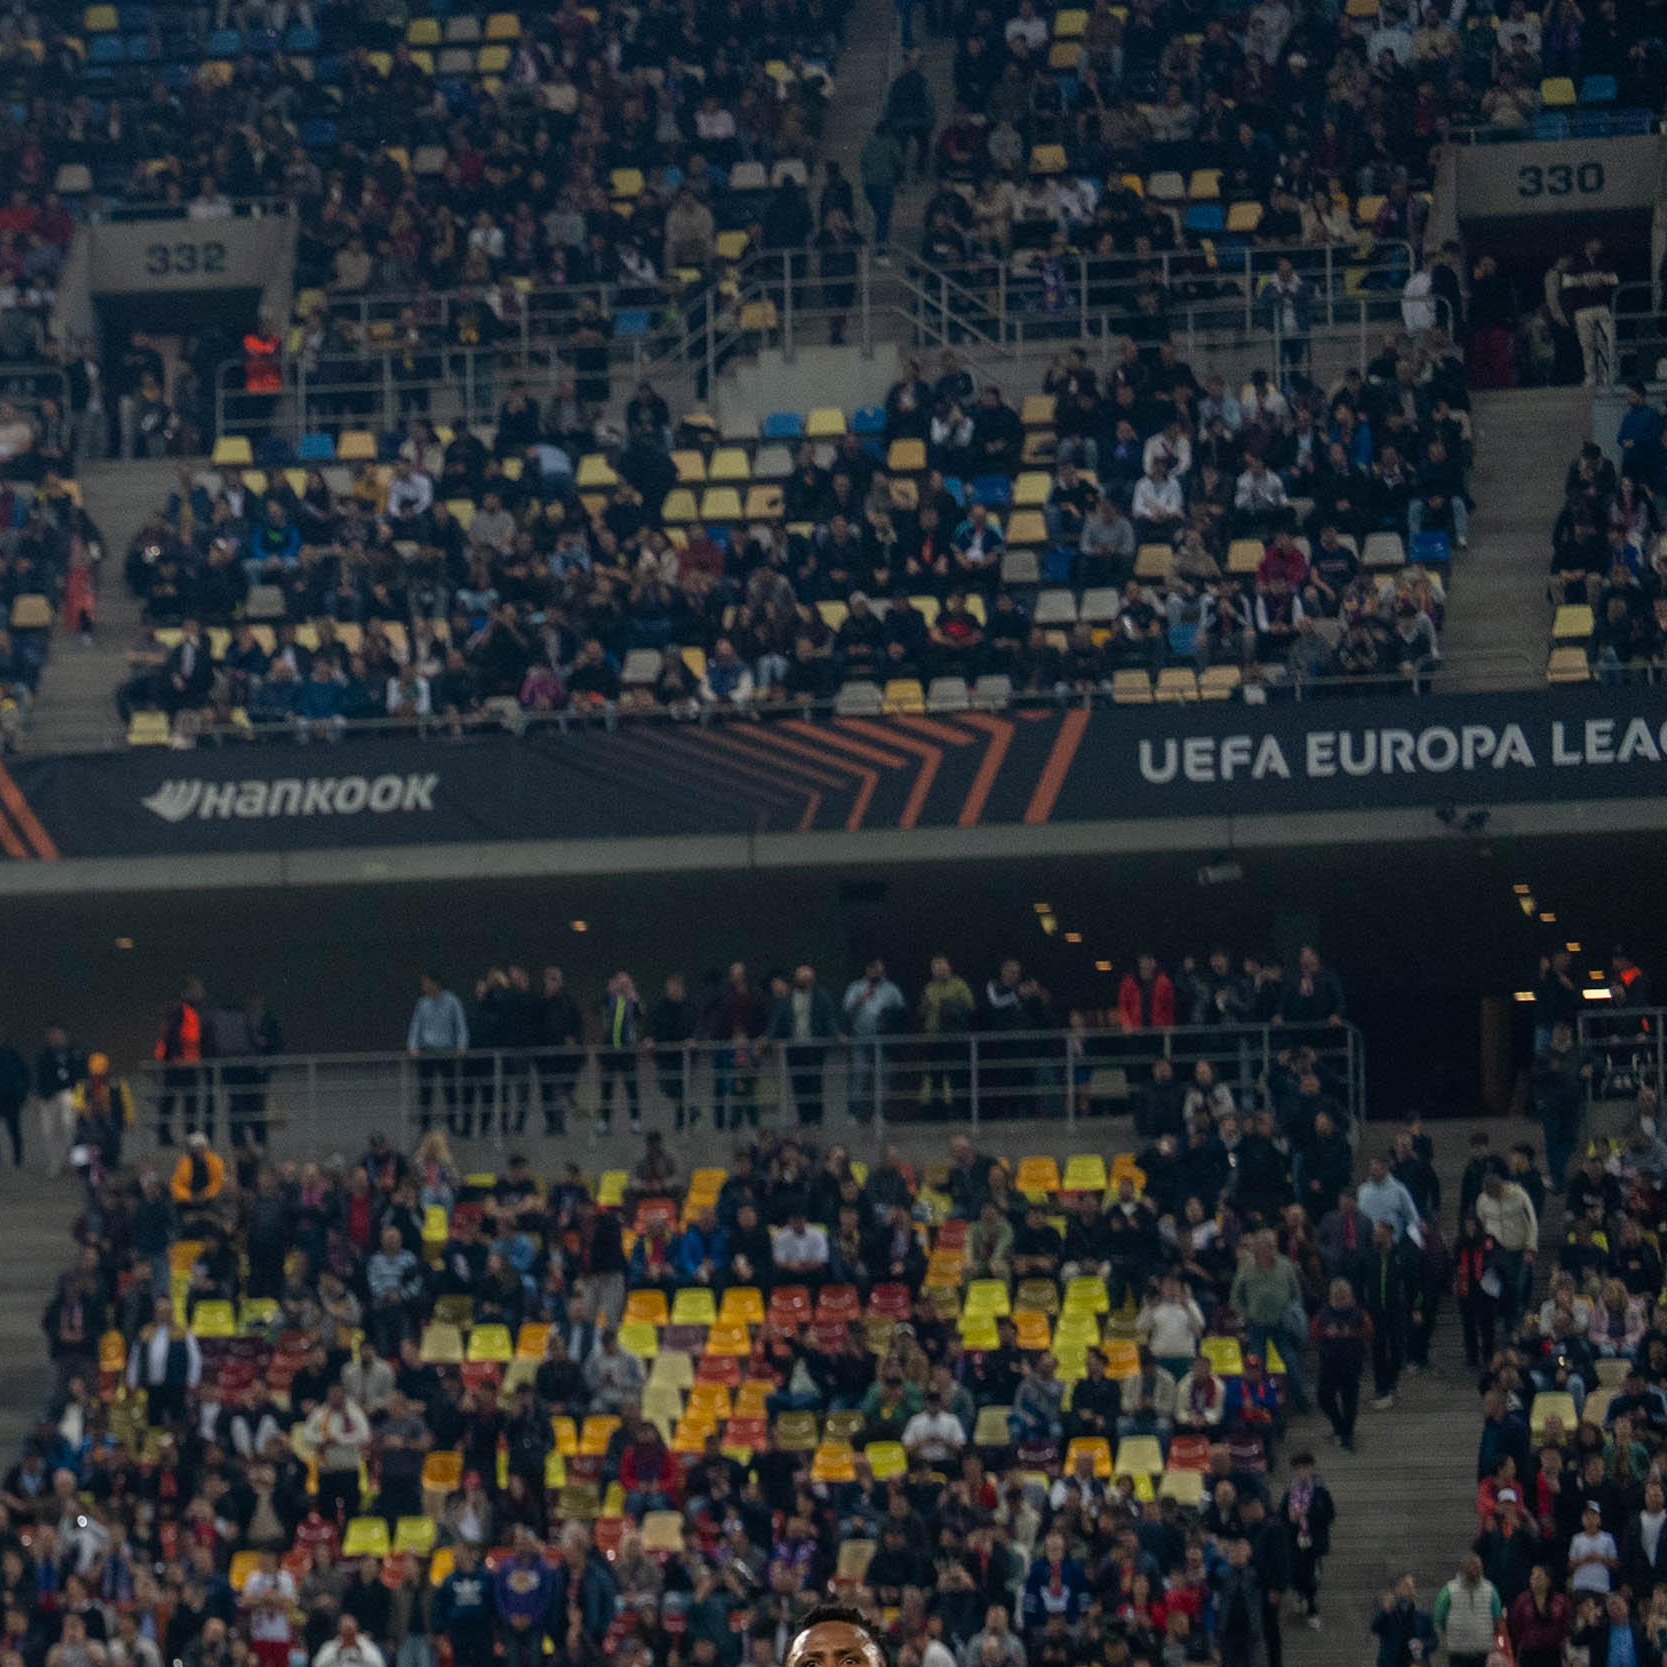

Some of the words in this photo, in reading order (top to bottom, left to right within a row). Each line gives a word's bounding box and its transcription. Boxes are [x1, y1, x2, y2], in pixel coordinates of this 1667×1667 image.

[1518, 162, 1605, 198] 330
[146, 241, 228, 277] 332
[1138, 734, 1291, 784] UEFA
[1305, 722, 1536, 778] EUROPA
[1551, 717, 1667, 767] LEA
